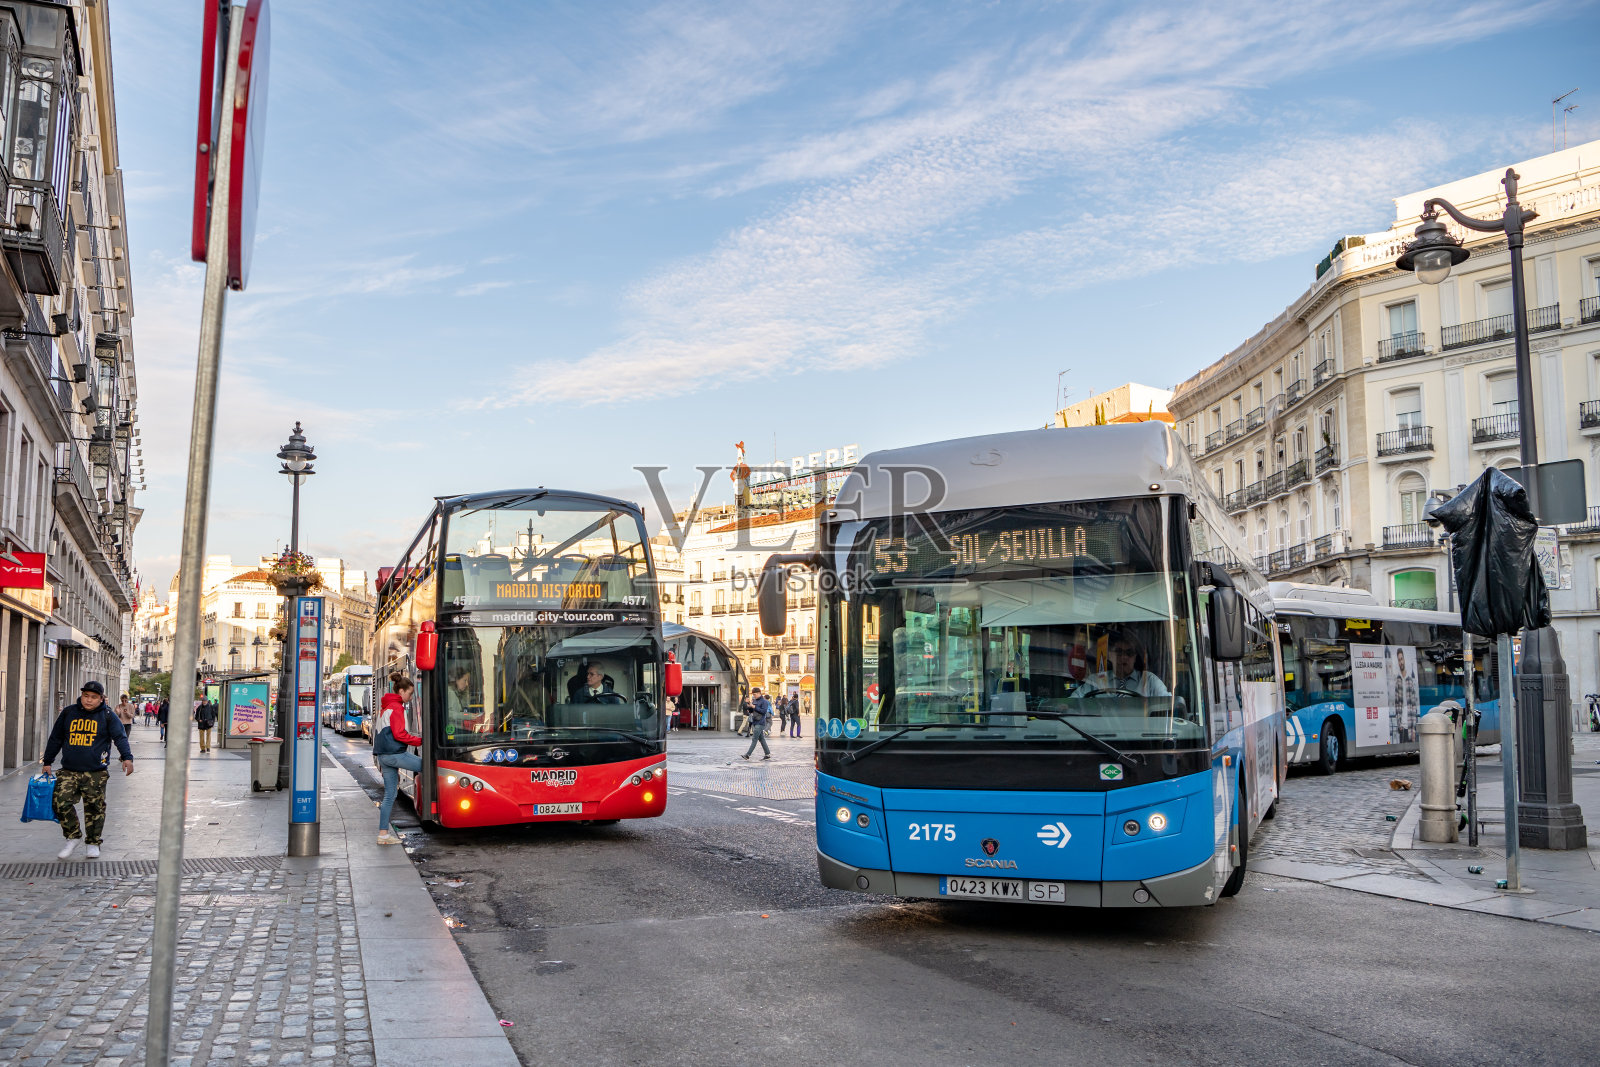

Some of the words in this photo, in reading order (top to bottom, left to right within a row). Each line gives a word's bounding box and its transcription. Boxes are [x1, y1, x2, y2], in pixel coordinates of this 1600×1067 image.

[792, 444, 858, 478] PEPE
[874, 537, 908, 574] 53
[949, 526, 1087, 566] SOL/SEVILLA
[2, 566, 42, 574] VIPS
[496, 583, 538, 599] MADRID
[541, 583, 602, 599] HISTORICO
[622, 595, 647, 606] 4577
[492, 611, 615, 623] madrid.city-tour.com
[69, 718, 98, 733] GOOD
[69, 732, 97, 747] GRIEF
[531, 769, 578, 783] MADRID
[539, 805, 561, 814] 0824
[564, 804, 580, 813] JYK
[908, 823, 956, 842] 2175
[964, 857, 1018, 870] SCANIA
[950, 879, 986, 895] 0423
[991, 881, 1019, 896] KWX
[1034, 884, 1060, 899] SP
